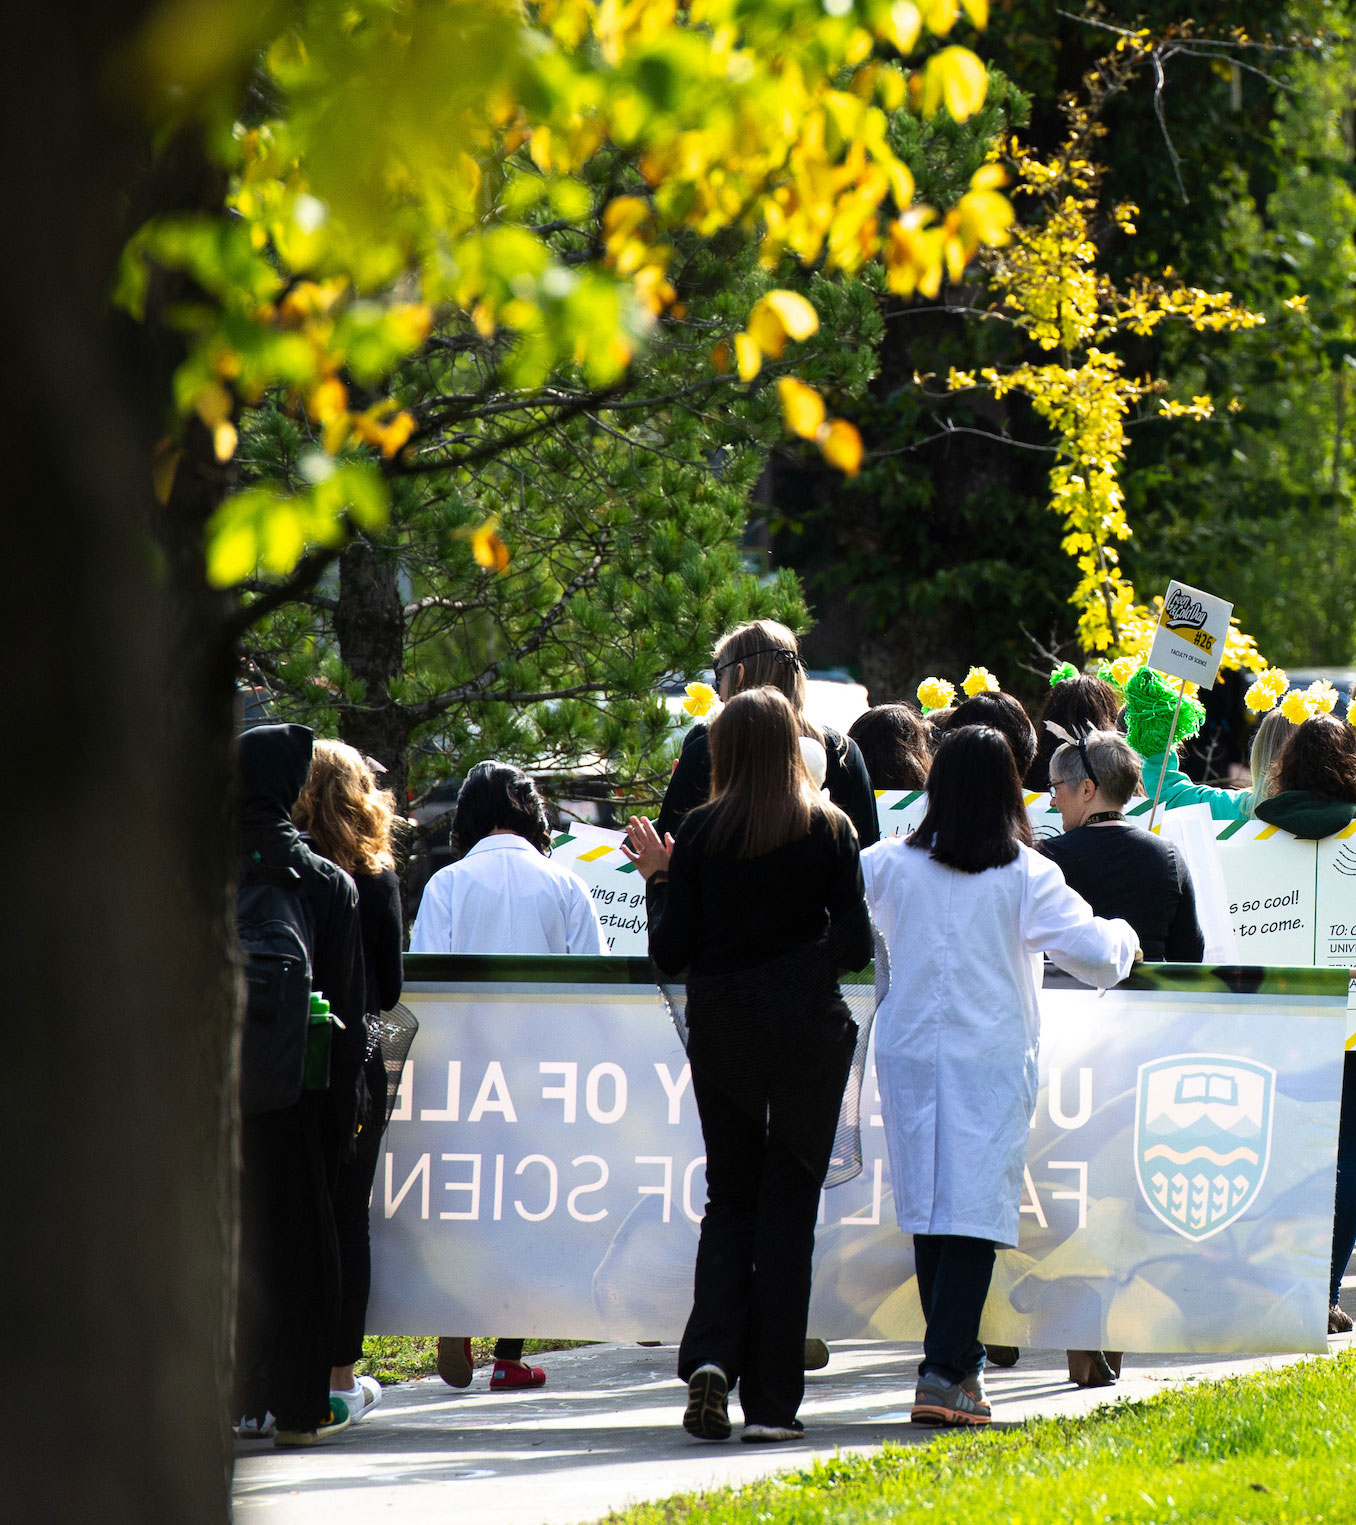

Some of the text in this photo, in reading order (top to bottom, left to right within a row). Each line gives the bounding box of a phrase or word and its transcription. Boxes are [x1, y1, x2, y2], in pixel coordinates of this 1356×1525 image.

[1193, 630, 1213, 651] #26
[1170, 648, 1189, 660] FACULTY
[590, 884, 647, 909] ing a gr
[1242, 900, 1261, 913] so
[1264, 889, 1300, 909] cool!
[599, 913, 648, 934] study
[1239, 923, 1257, 937] to
[1260, 918, 1305, 934] come.
[1329, 924, 1348, 936] TO:
